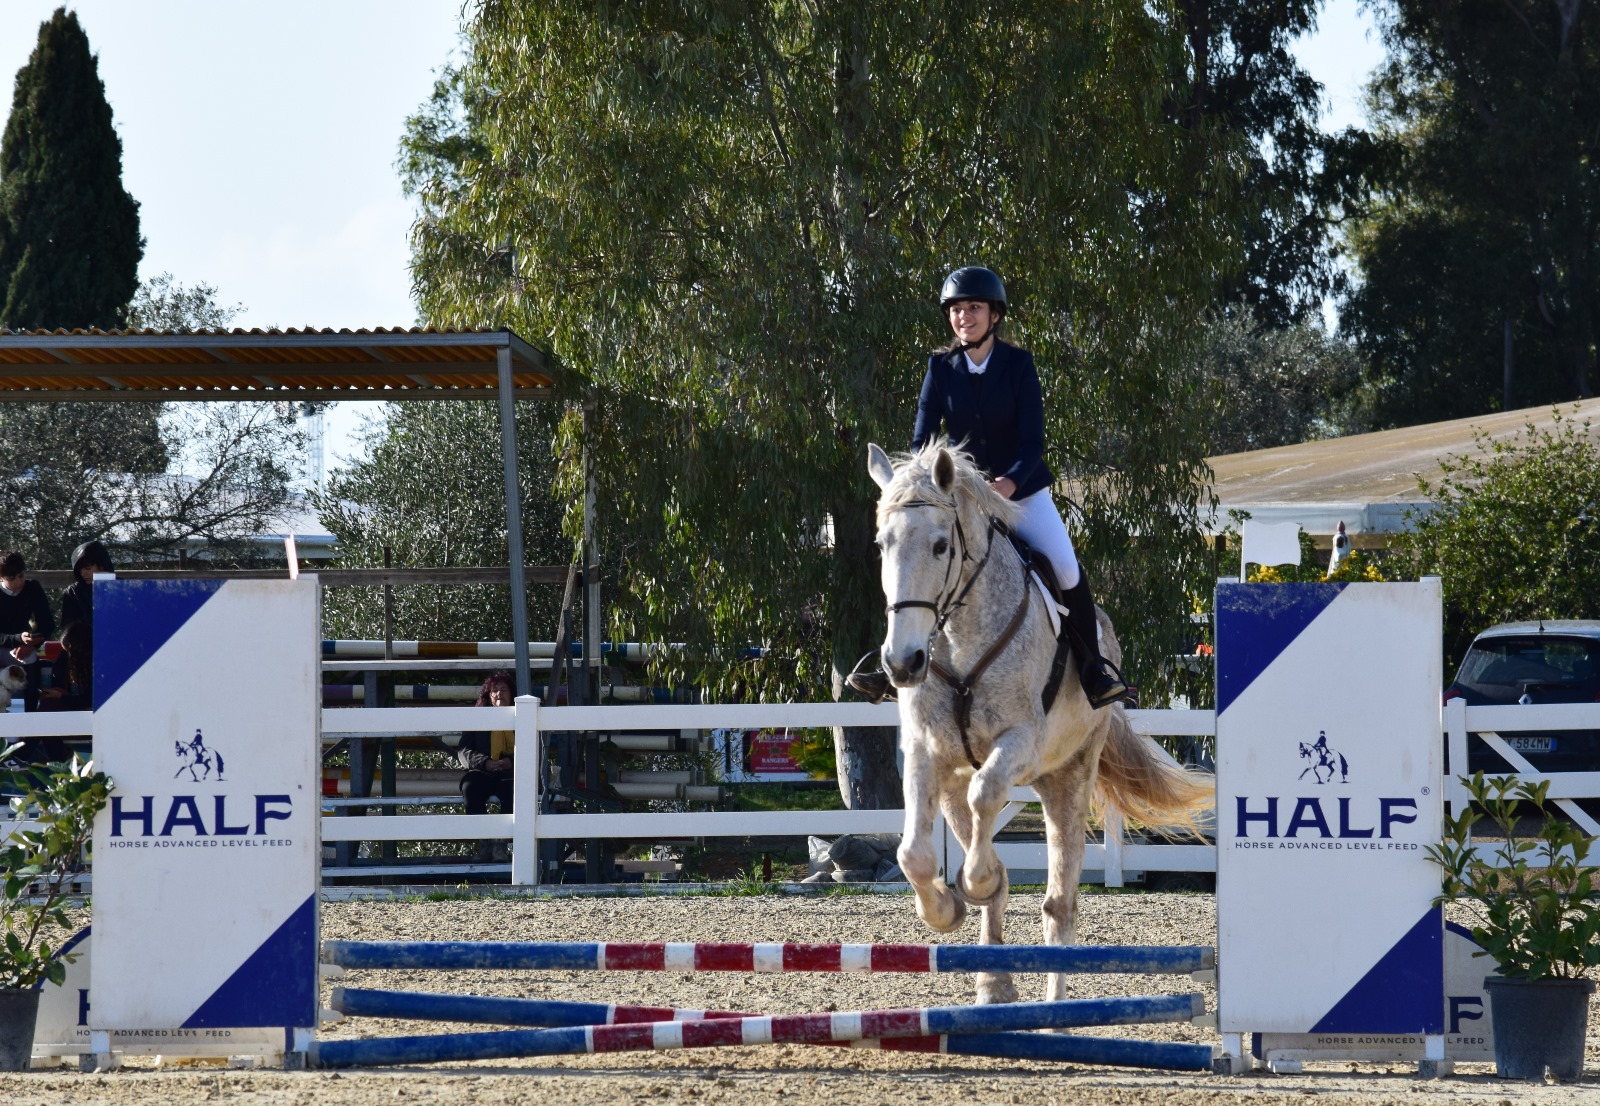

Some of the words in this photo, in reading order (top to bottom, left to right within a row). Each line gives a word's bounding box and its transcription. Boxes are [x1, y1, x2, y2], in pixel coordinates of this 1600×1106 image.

[110, 794, 293, 837] HALF
[1235, 796, 1418, 838] HALF
[153, 840, 217, 848] ADVANCED
[262, 839, 293, 847] FEED
[1278, 842, 1343, 850] ADVANCED
[1456, 1037, 1484, 1045] FEED
